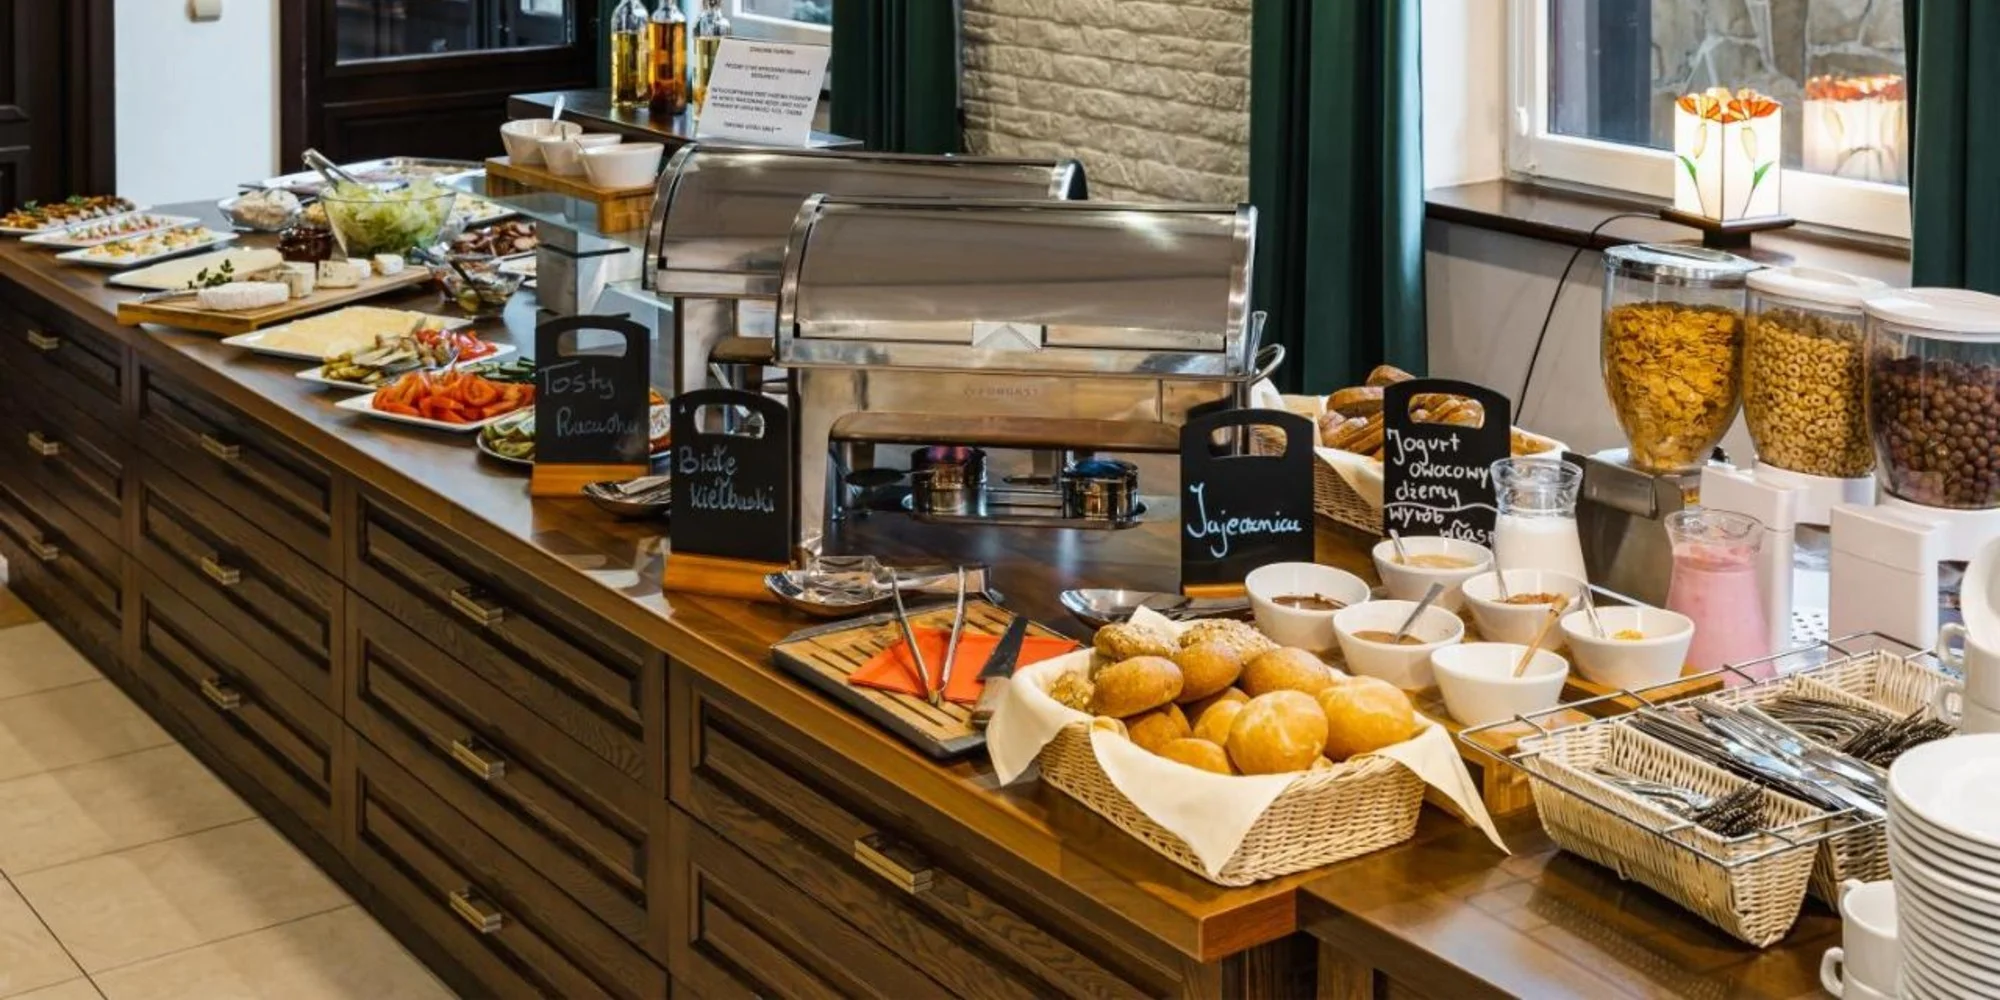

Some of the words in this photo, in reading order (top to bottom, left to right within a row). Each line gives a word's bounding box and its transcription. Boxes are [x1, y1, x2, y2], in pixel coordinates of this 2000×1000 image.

[538, 360, 615, 399] Tosty
[679, 444, 738, 475] Białe
[1387, 427, 1460, 465] Jogurt
[1409, 462, 1489, 489] owocowy
[1395, 480, 1461, 511] dżemy
[1388, 506, 1444, 528] wyrób
